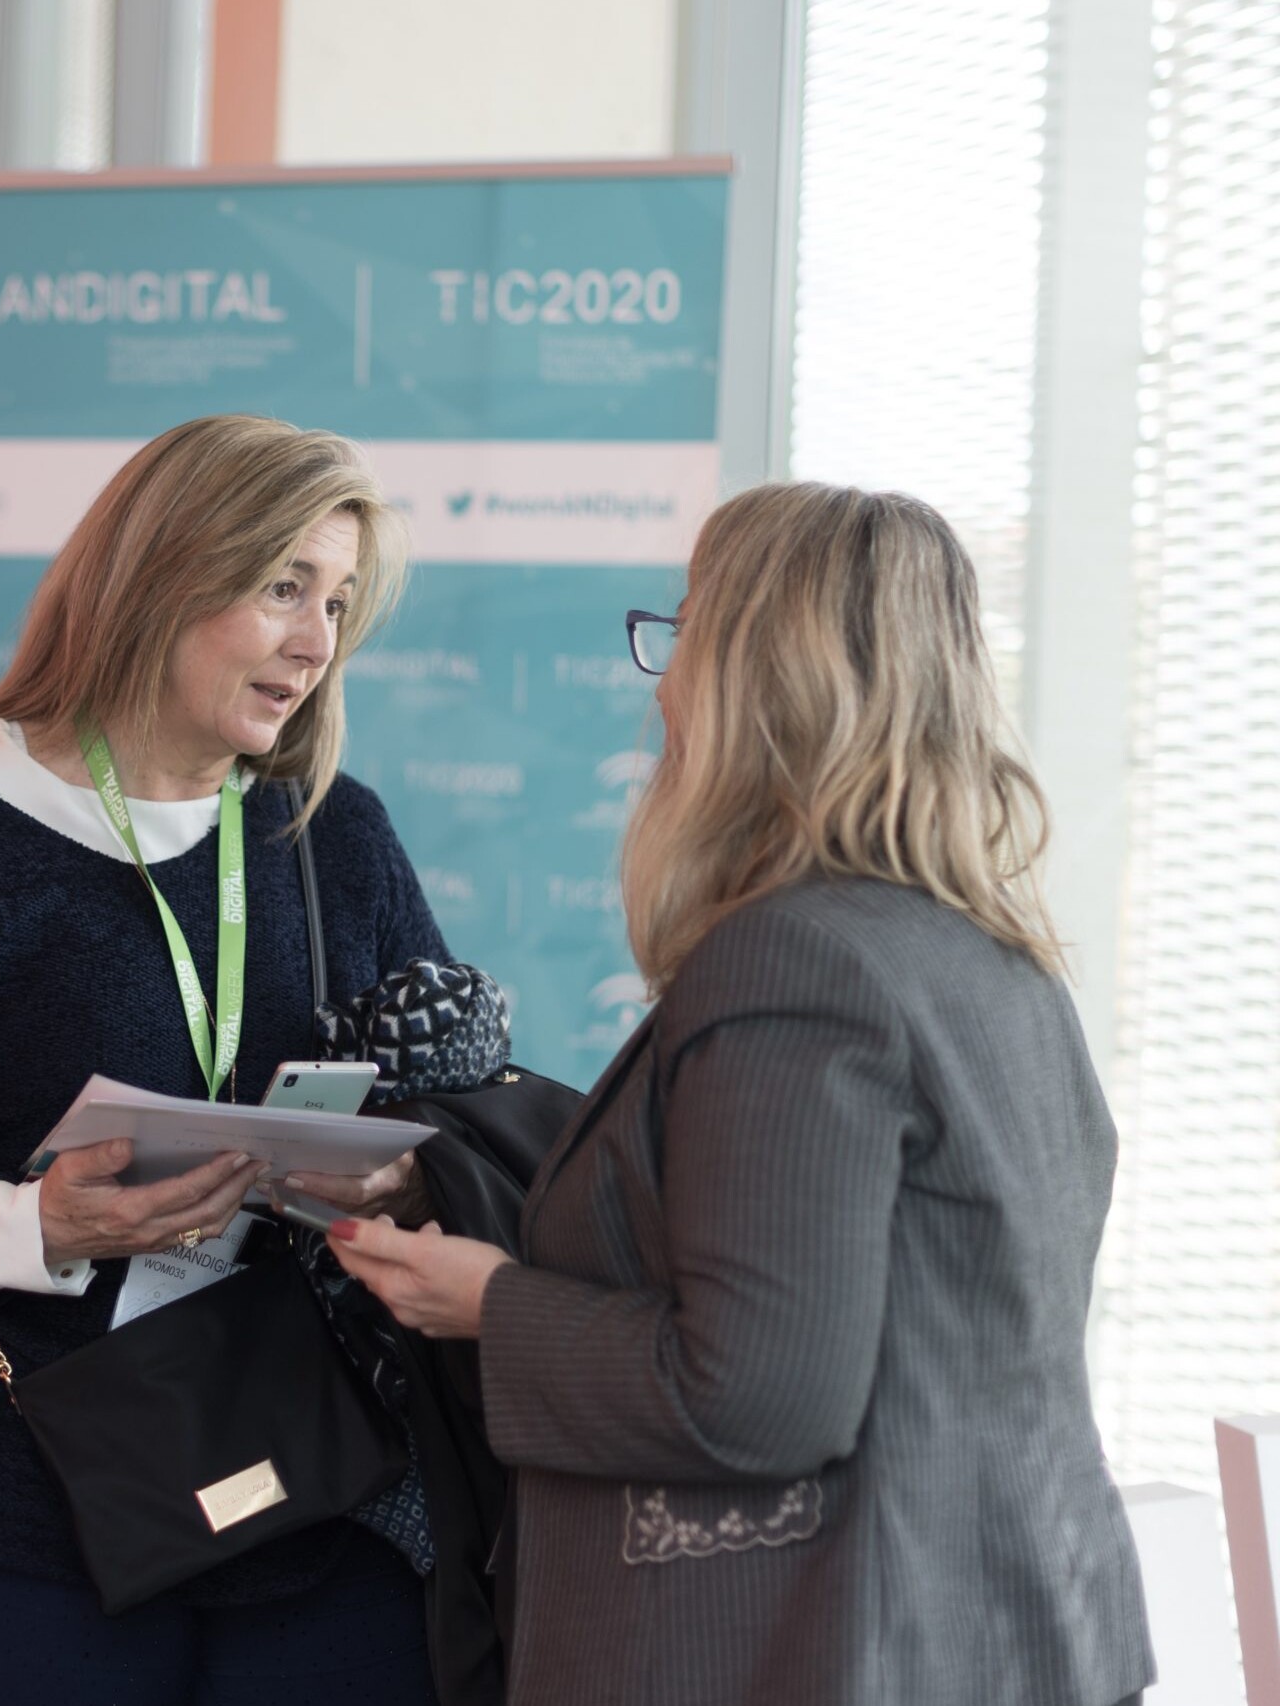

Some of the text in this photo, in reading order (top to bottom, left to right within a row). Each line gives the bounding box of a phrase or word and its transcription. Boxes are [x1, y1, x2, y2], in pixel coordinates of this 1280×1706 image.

[431, 267, 683, 326] TIC2020
[304, 1099, 325, 1110] bq
[144, 1257, 187, 1280] WOM035
